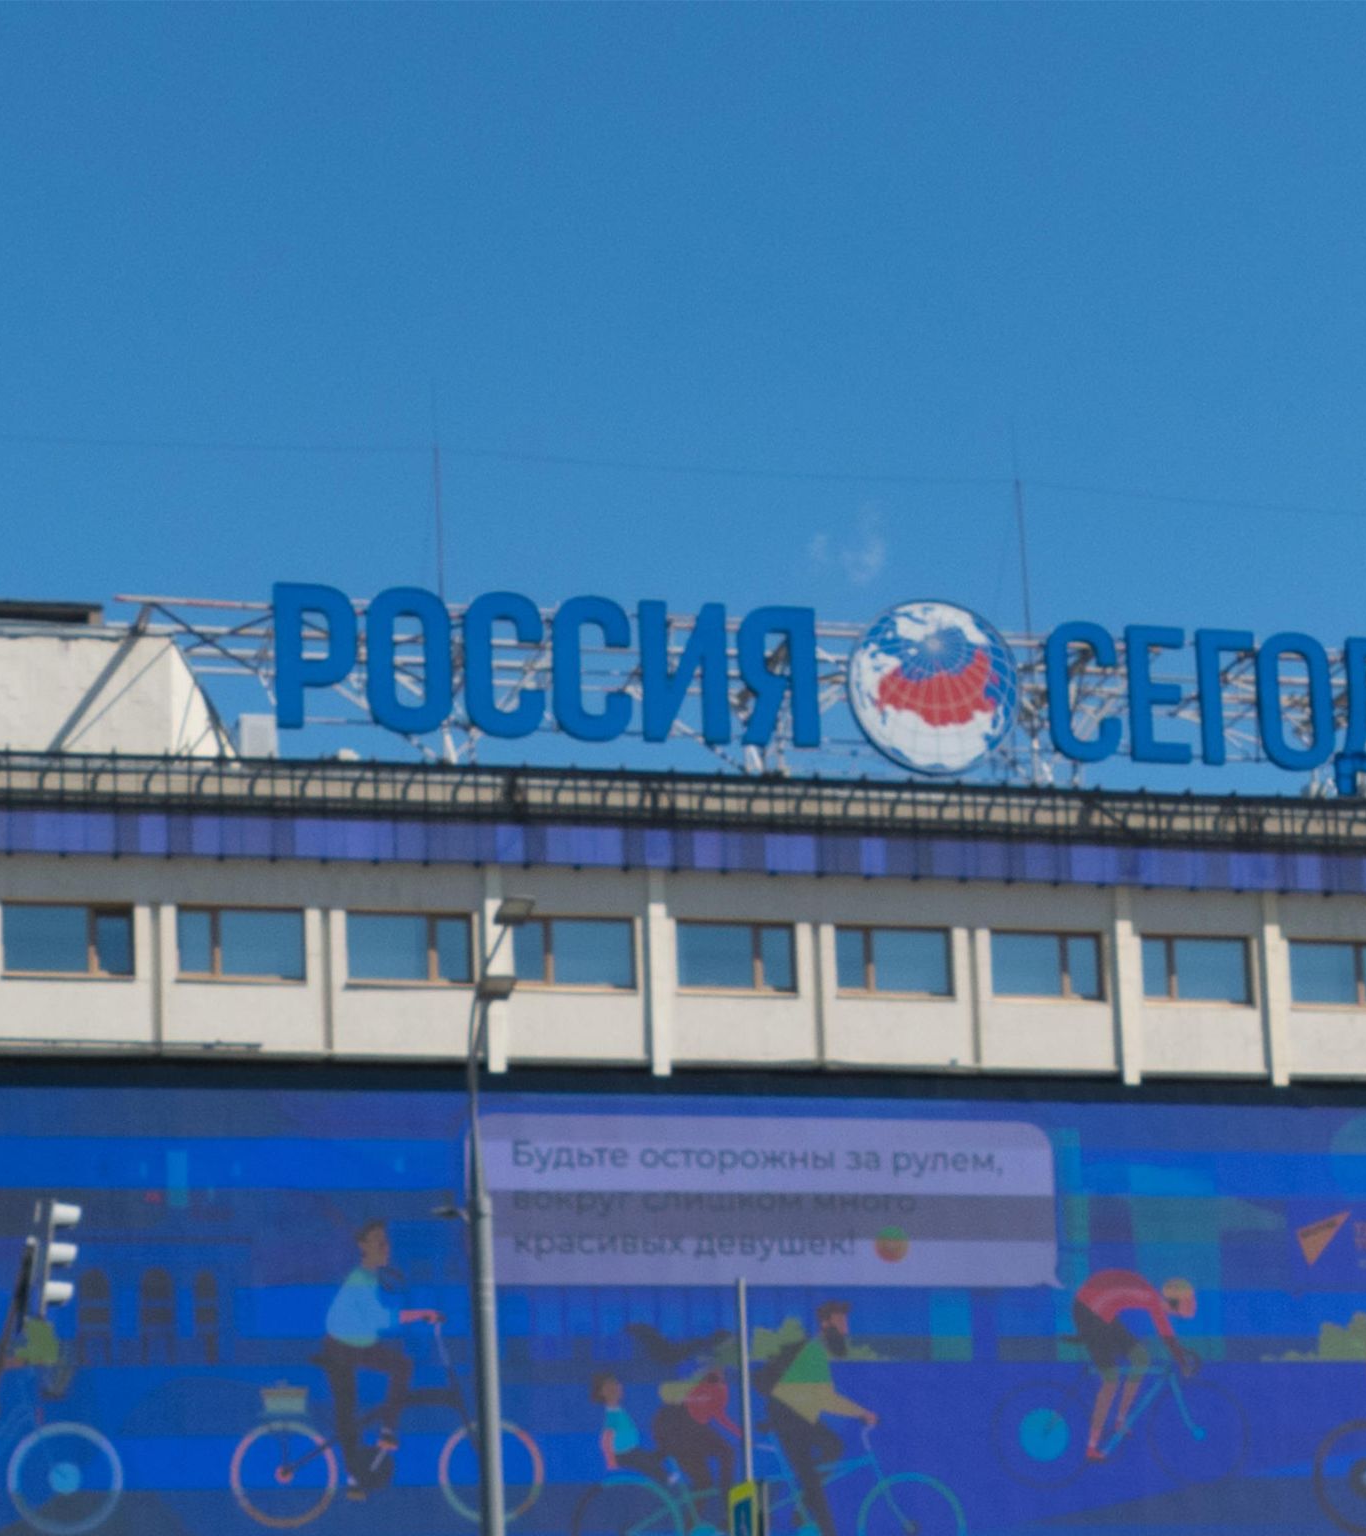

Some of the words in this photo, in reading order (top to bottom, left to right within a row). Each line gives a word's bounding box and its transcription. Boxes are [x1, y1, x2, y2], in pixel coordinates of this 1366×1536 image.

[273, 581, 821, 748] РОССИЯ
[512, 1139, 628, 1174] Будьте
[639, 1147, 834, 1174] осторожны
[845, 1150, 881, 1171] за
[892, 1150, 1003, 1178] рулем,
[513, 1189, 627, 1217] вокруг
[641, 1190, 803, 1212] слишком
[813, 1192, 917, 1213] много
[514, 1233, 682, 1260] красивых
[692, 1229, 856, 1262] девушек!
